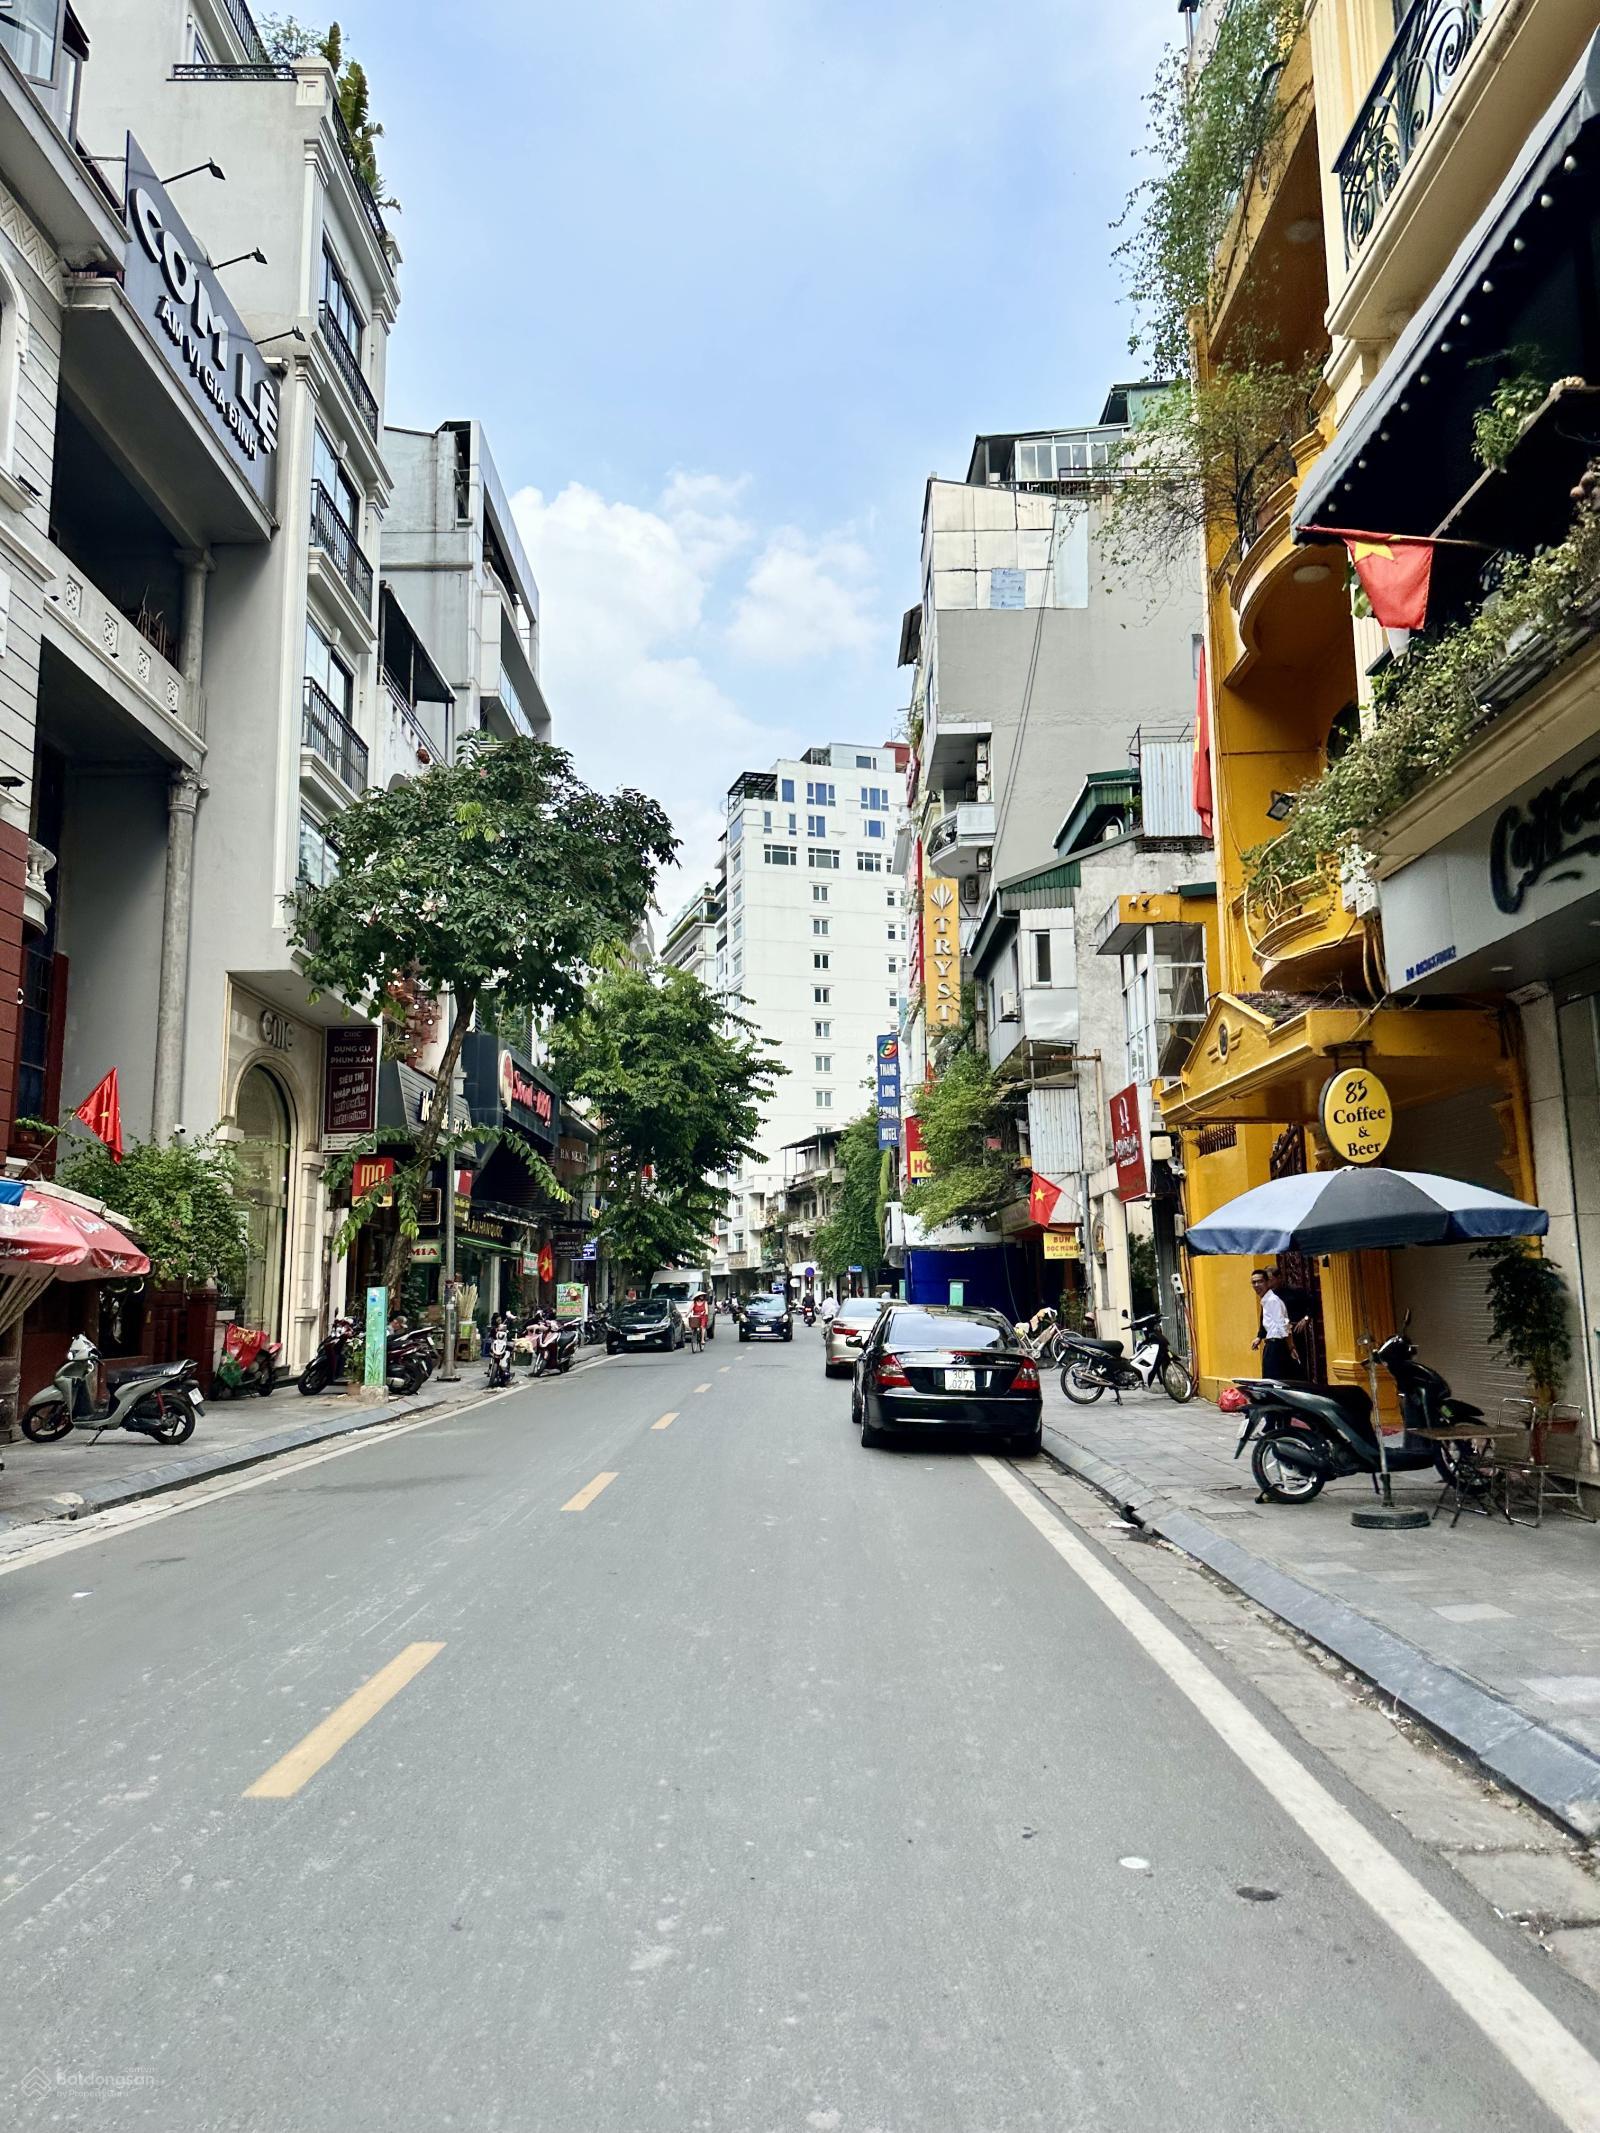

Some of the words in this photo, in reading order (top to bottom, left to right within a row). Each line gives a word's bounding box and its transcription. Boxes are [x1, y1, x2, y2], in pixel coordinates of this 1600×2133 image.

[202, 367, 226, 412] GIA
[934, 915, 952, 1022] TRYST
[1345, 1077, 1368, 1104] 85
[1333, 1106, 1386, 1125] Coffee
[881, 1127, 898, 1141] HOTEL
[1358, 1125, 1371, 1138] &
[1347, 1142, 1382, 1157] Beer
